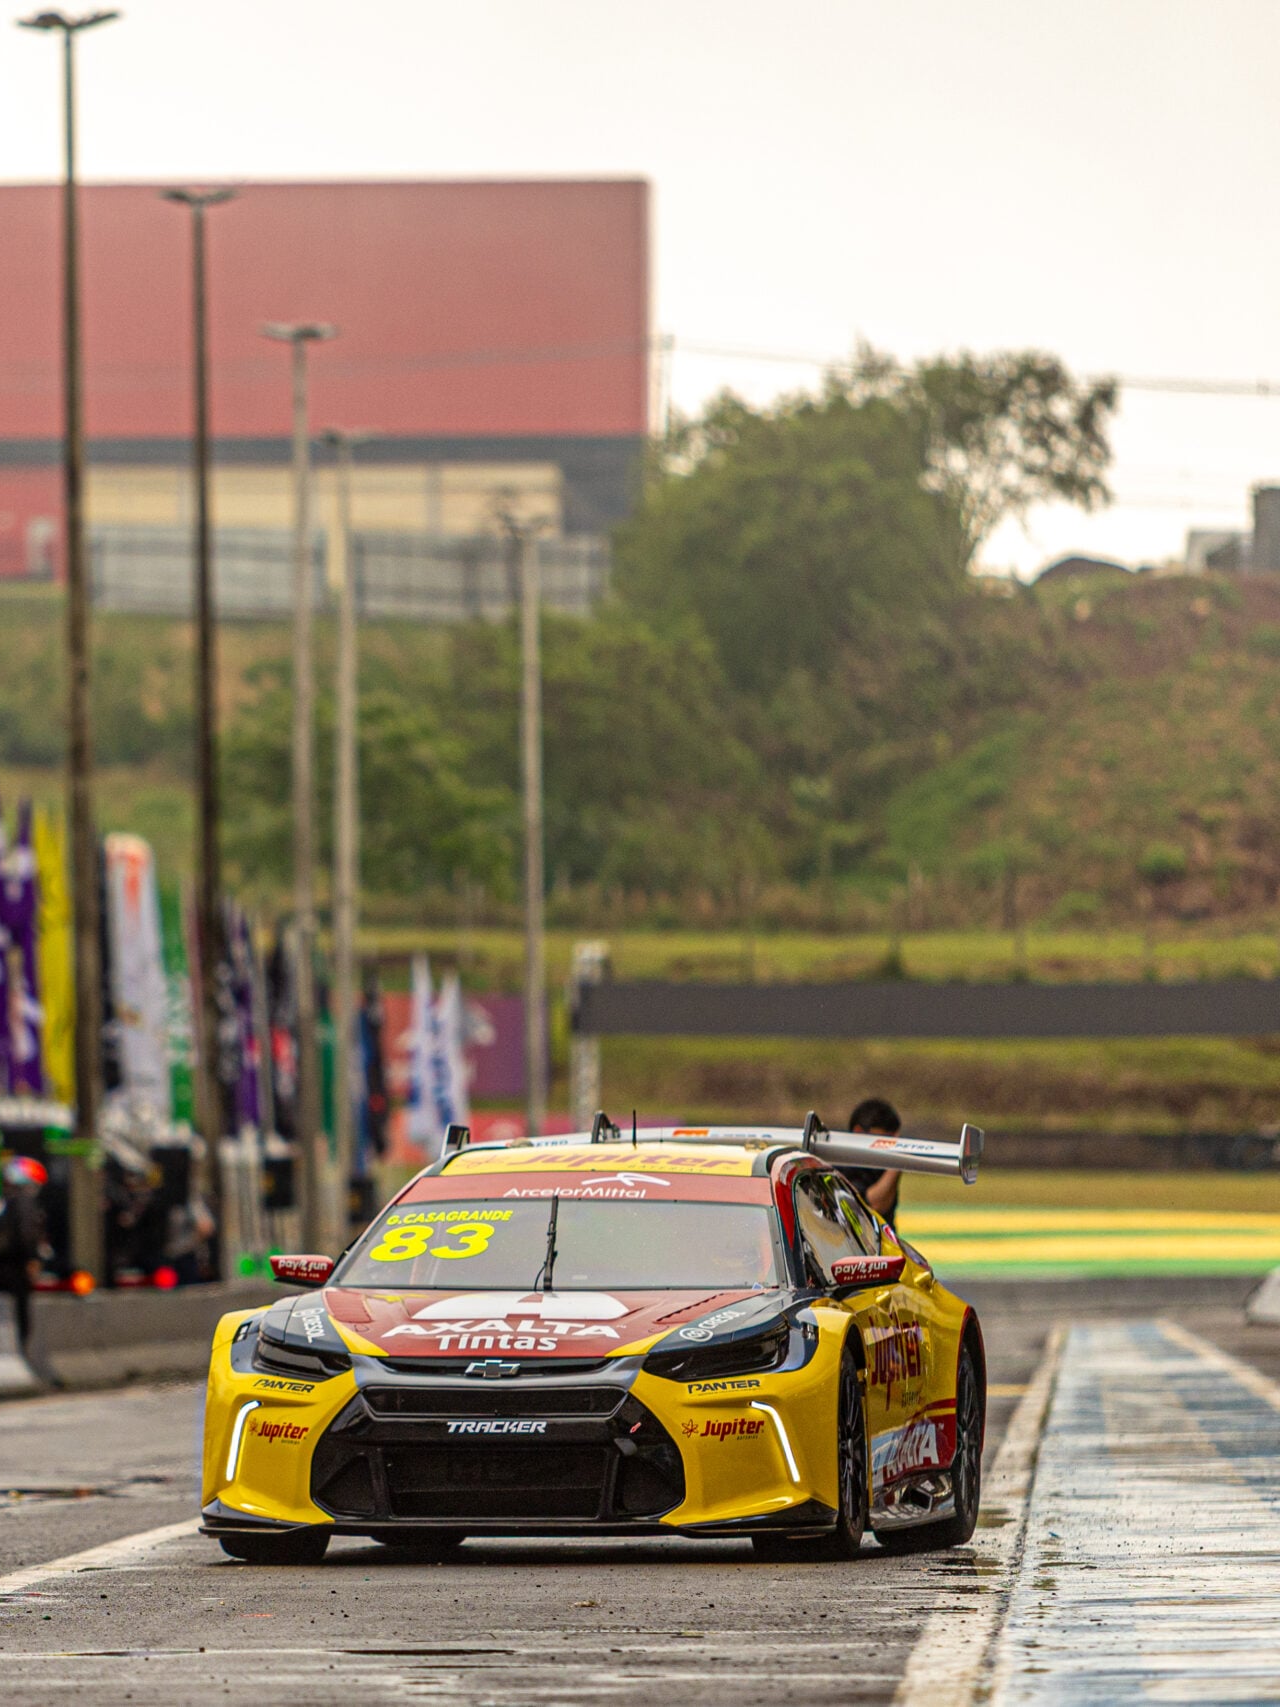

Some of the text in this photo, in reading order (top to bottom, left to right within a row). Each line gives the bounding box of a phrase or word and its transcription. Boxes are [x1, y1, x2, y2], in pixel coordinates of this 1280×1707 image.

[503, 1187, 646, 1199] ArcelorMittal
[387, 1210, 513, 1225] G.CASAGRANDE
[370, 1223, 495, 1262] 83
[381, 1320, 621, 1339] AXALTA
[436, 1334, 558, 1351] Tintas
[253, 1379, 315, 1393] PANTER
[687, 1379, 761, 1394] PANTER
[447, 1421, 547, 1433] TRACKER
[700, 1418, 765, 1442] Júpiter
